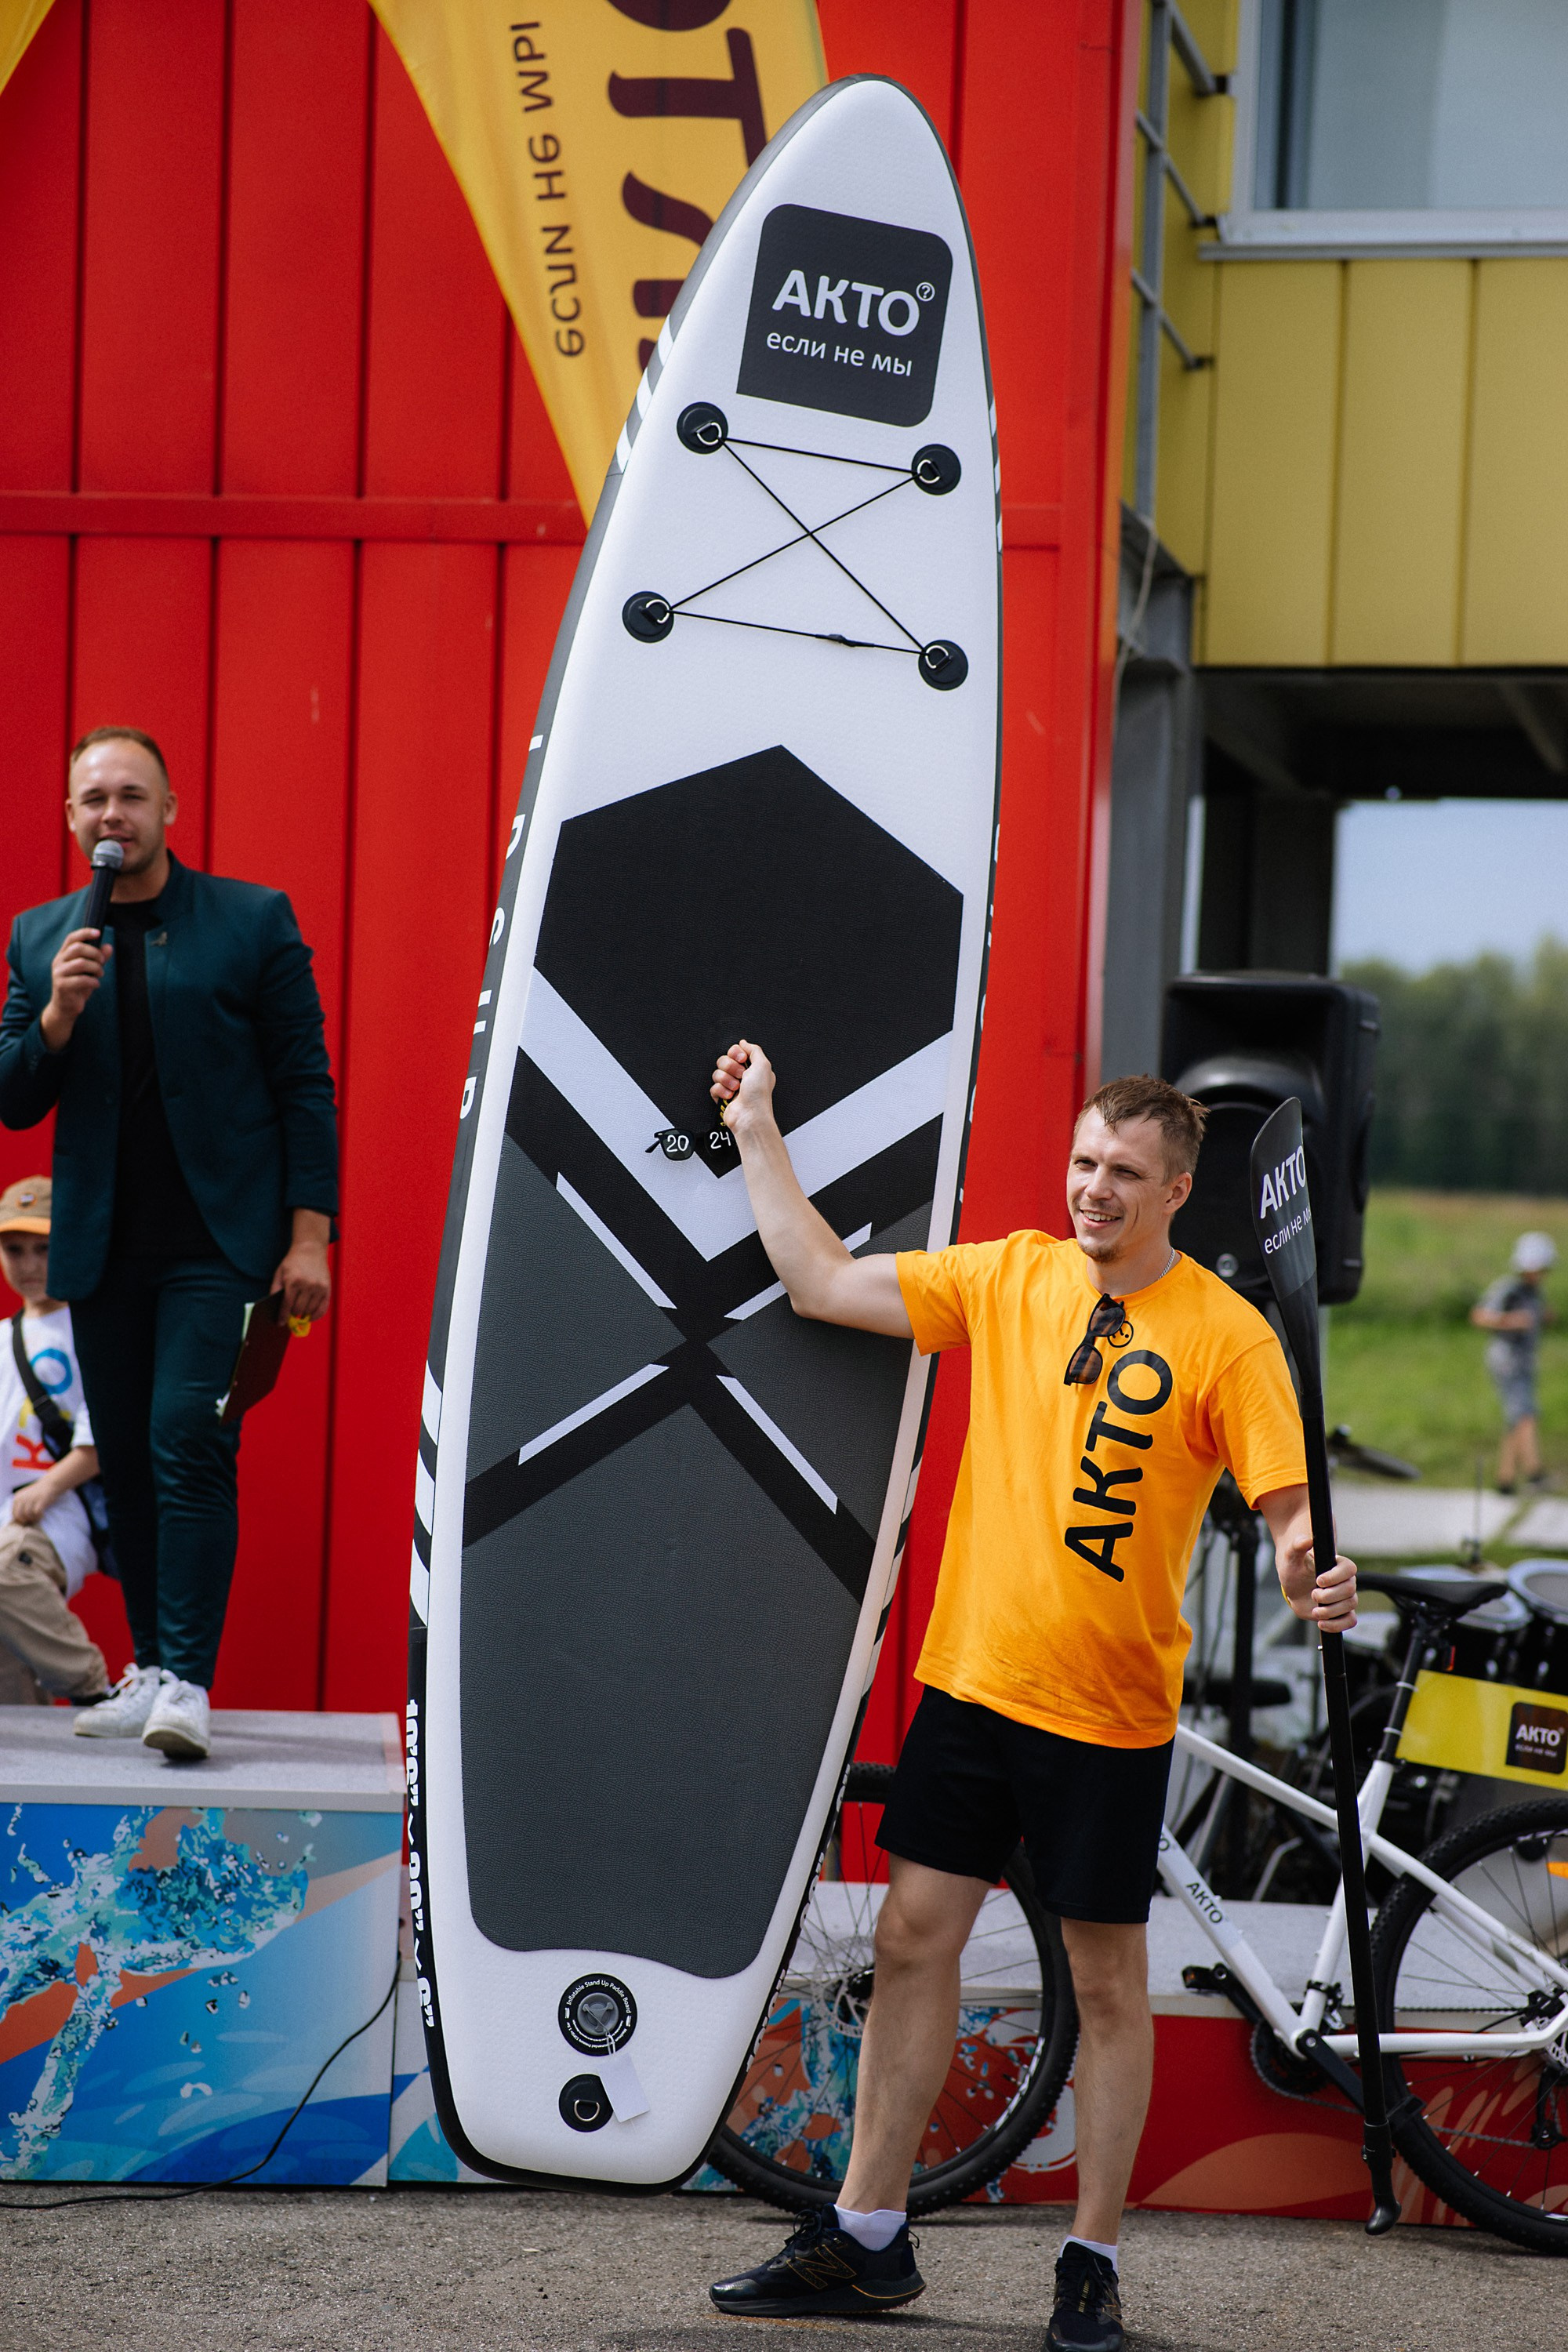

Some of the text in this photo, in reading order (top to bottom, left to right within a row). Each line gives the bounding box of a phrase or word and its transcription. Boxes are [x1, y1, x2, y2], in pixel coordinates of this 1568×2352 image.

[771, 269, 920, 336] АКТО
[766, 332, 913, 377] если не мы
[666, 1131, 731, 1152] 20 24
[1259, 1145, 1306, 1219] АКТО
[1265, 1226, 1291, 1254] если
[1291, 1214, 1303, 1236] не
[1064, 1348, 1174, 1584] АКТО
[1515, 1723, 1561, 1747] АКТО
[1186, 1882, 1223, 1923] АКТО
[566, 1984, 586, 2005] Inflatable
[584, 1979, 601, 1987] Stand
[609, 1982, 625, 1998] Paddle
[622, 1997, 632, 2013] Board
